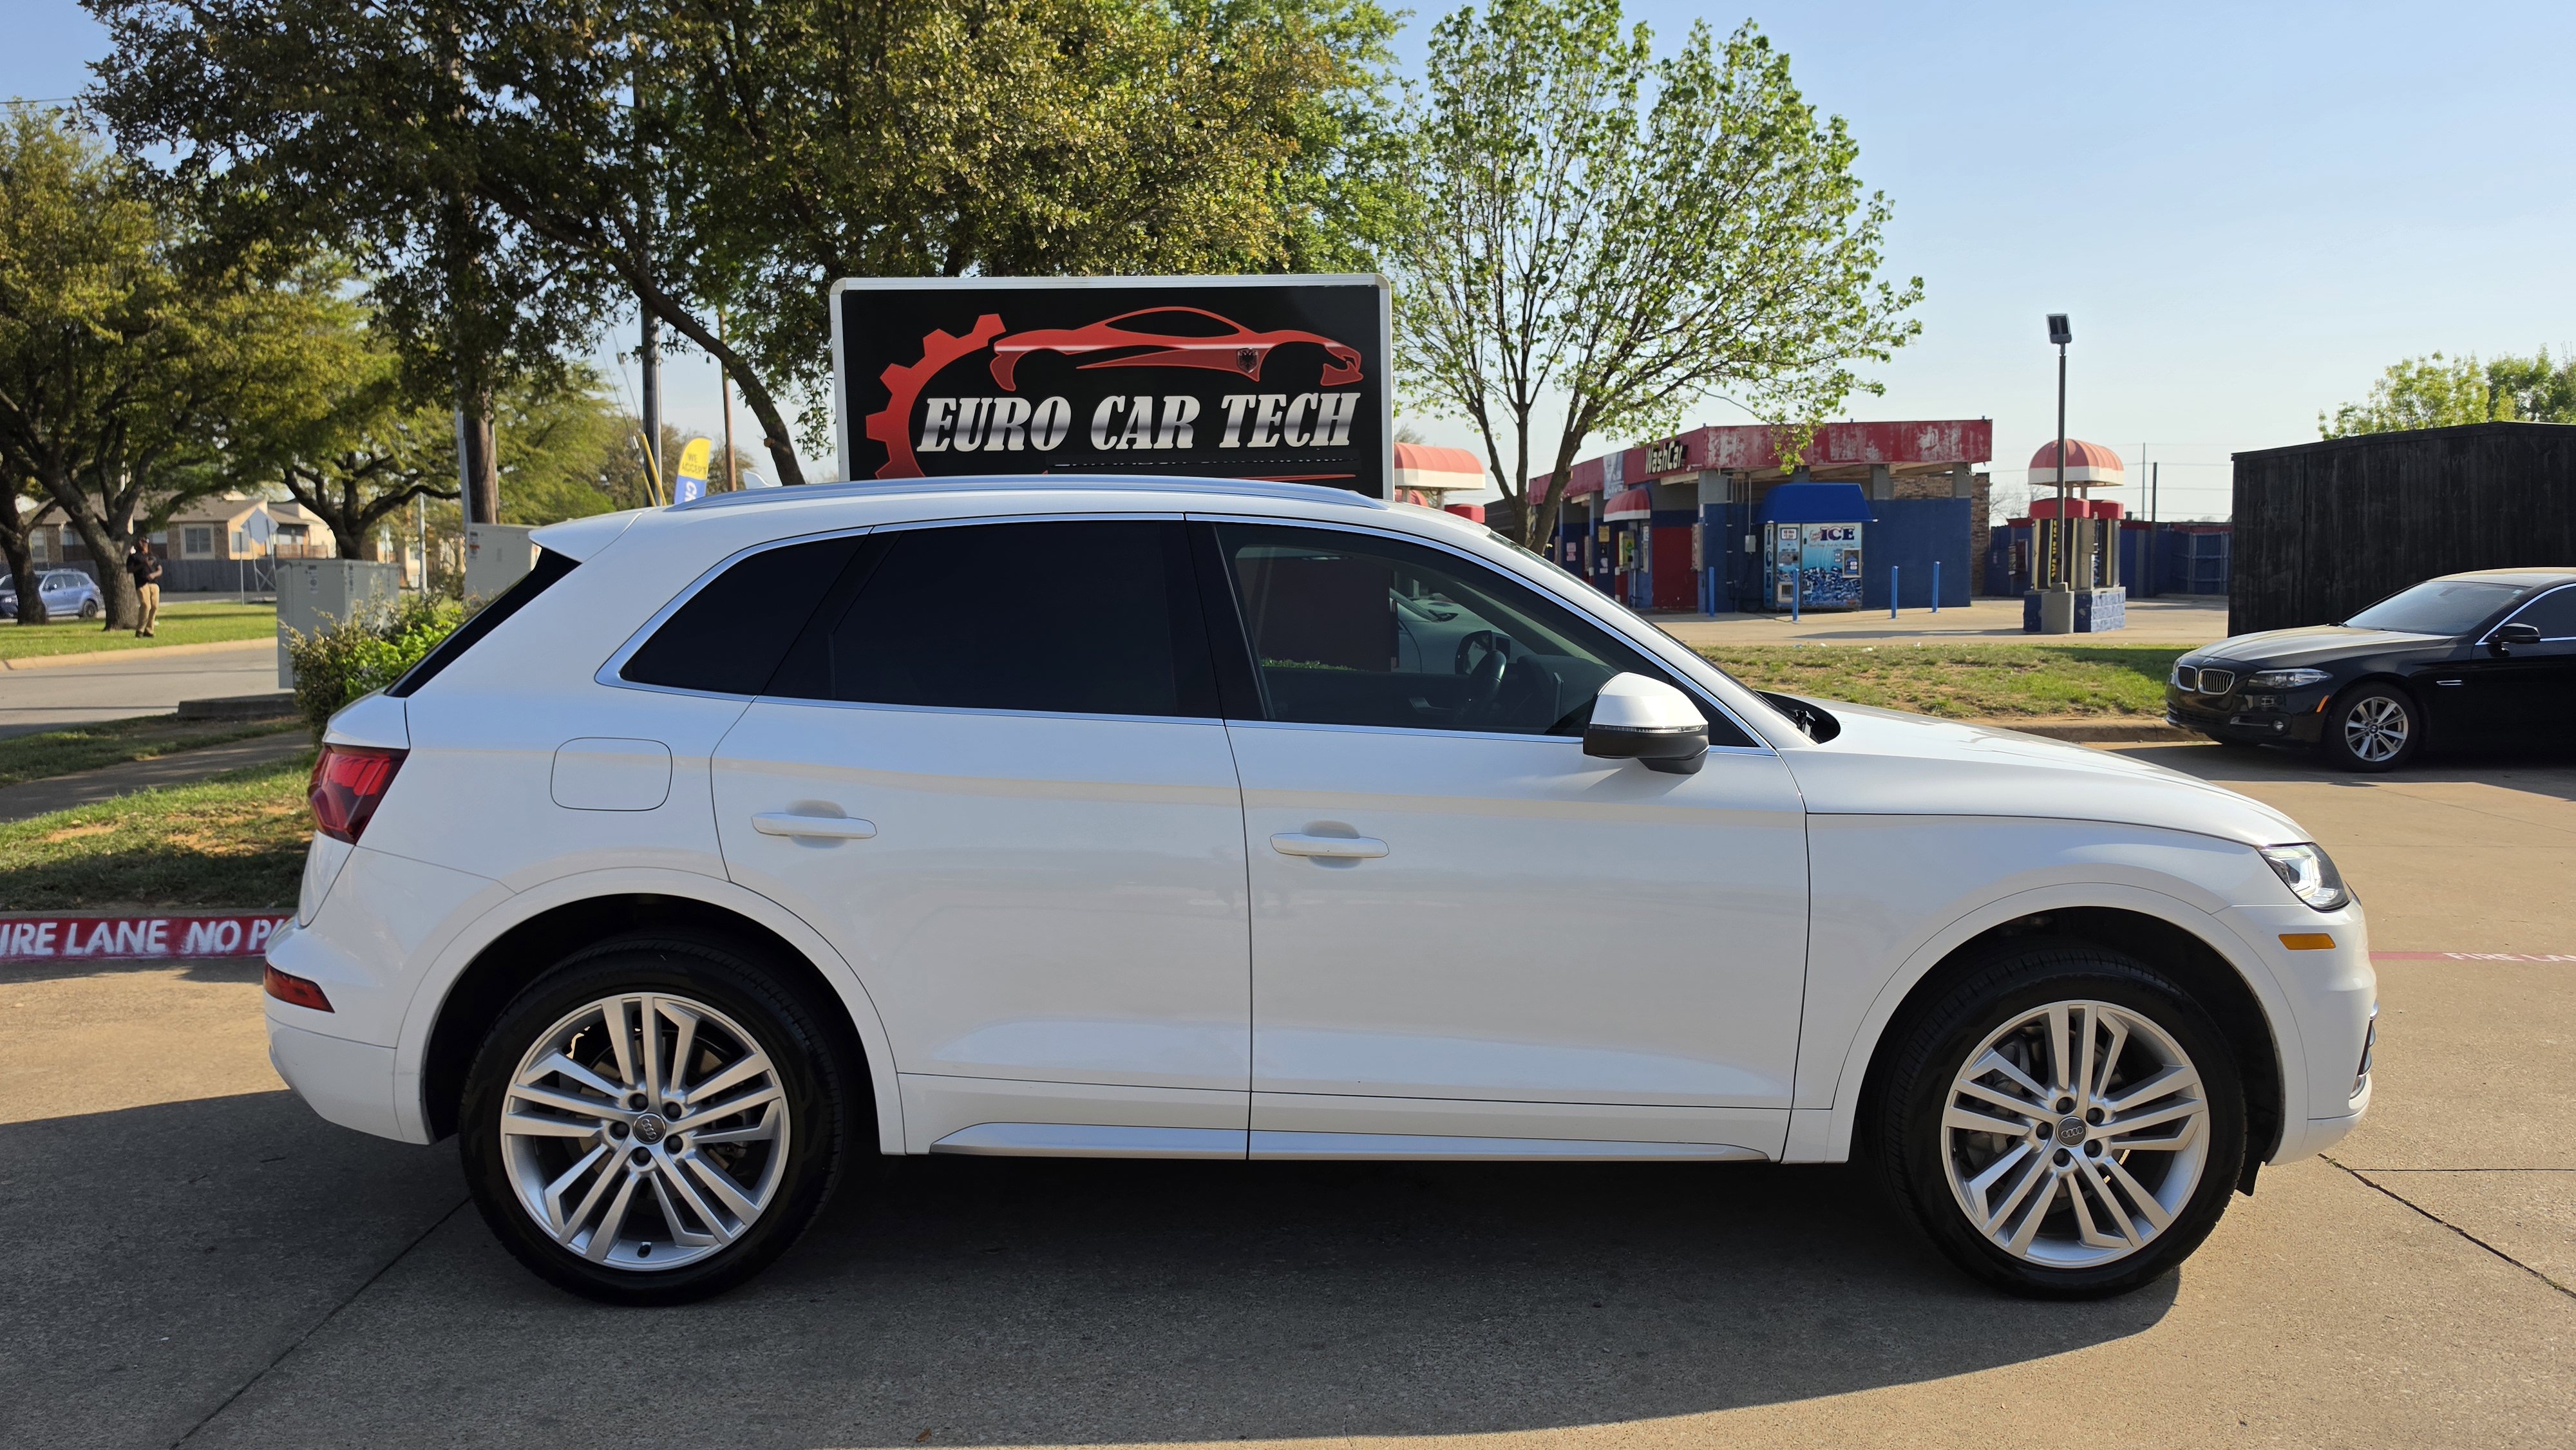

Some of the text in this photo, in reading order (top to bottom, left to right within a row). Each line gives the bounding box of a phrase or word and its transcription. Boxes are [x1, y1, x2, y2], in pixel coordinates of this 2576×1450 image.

[916, 392, 1361, 452] EURO CAR TECH
[687, 452, 698, 462] WE
[681, 462, 707, 474] ACCEPT
[1820, 525, 1855, 541] ICE
[0, 922, 58, 956] IRE
[64, 920, 169, 956] LANE
[180, 920, 242, 954] NO
[2443, 952, 2525, 961] FIRE
